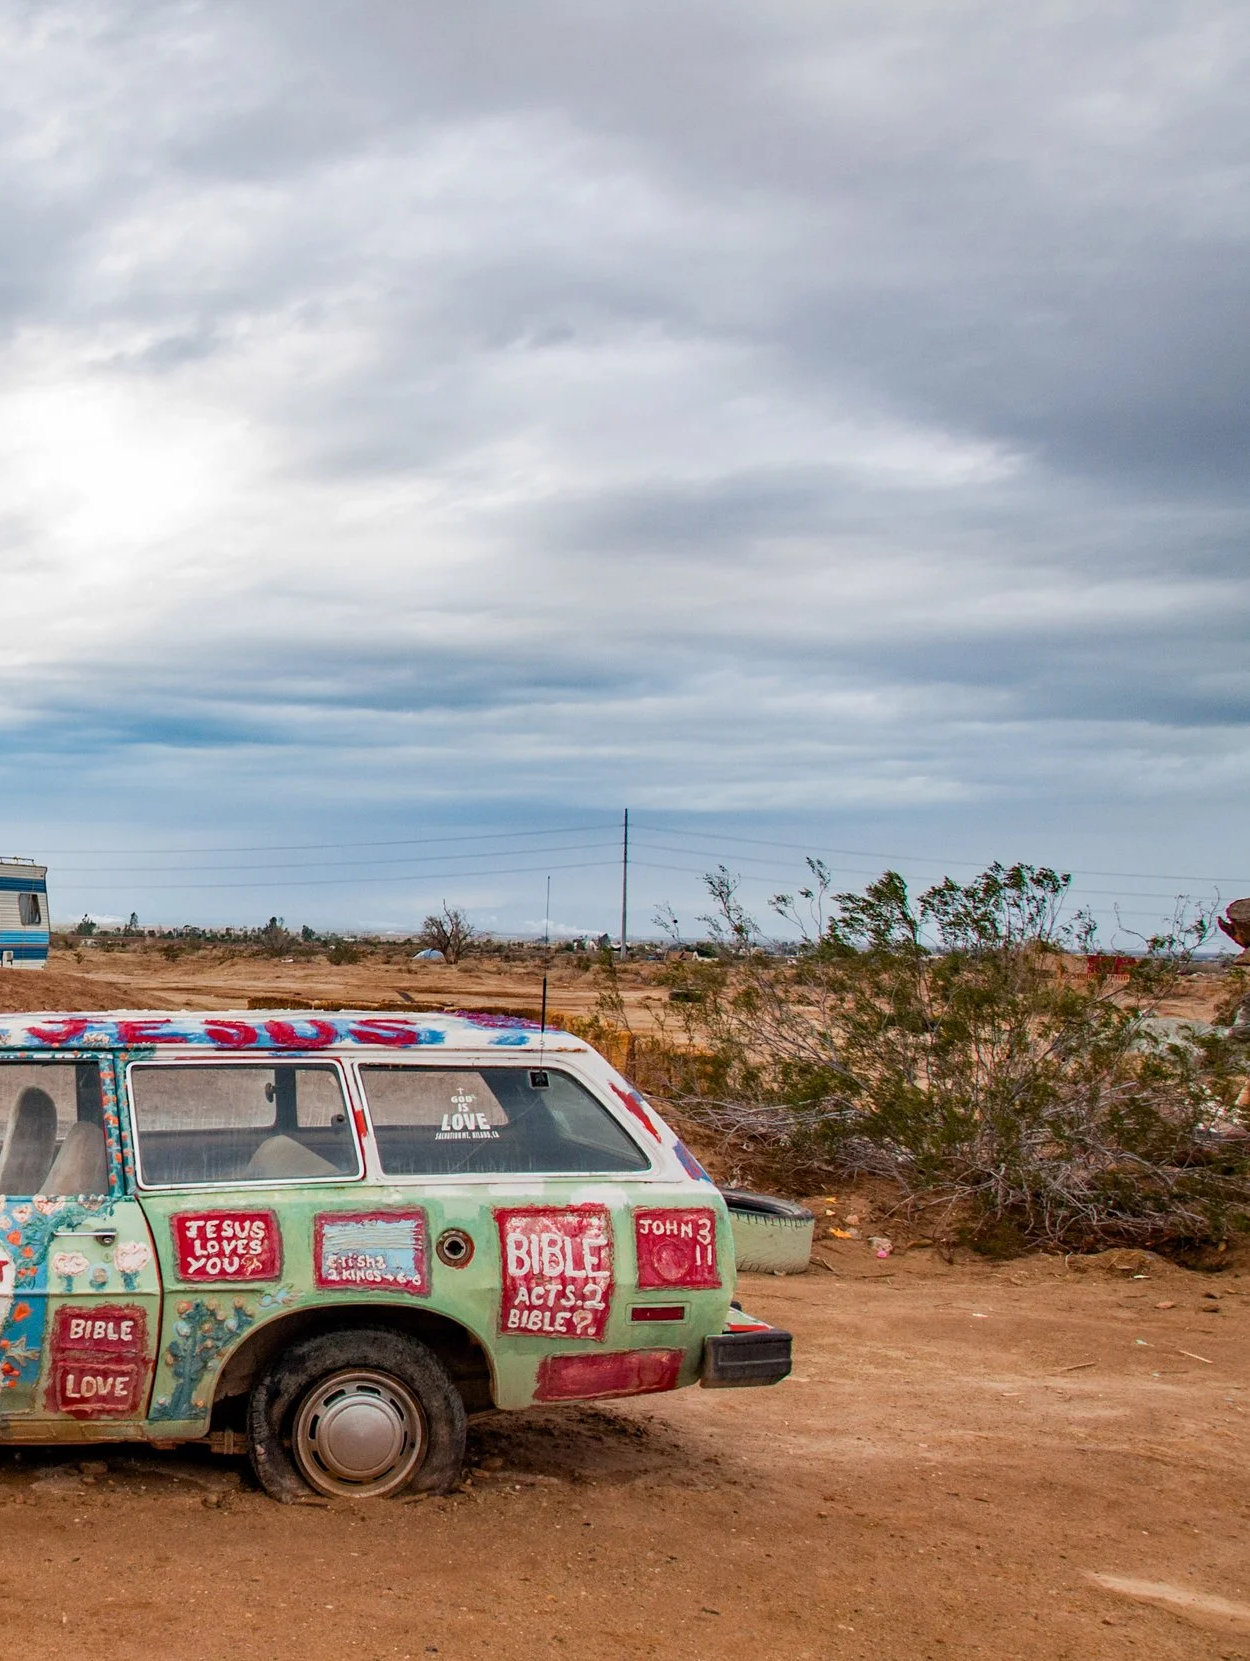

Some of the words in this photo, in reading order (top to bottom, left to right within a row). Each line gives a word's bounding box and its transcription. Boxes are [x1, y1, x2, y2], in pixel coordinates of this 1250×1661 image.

[23, 1018, 415, 1048] JESUS
[451, 1095, 473, 1104] GOD
[458, 1103, 469, 1112] IS
[441, 1112, 491, 1131] LOVE
[185, 1220, 266, 1239] JESUS
[639, 1219, 693, 1238] JOHN
[697, 1218, 712, 1245] 3
[194, 1239, 263, 1257] LOVES
[506, 1231, 611, 1279] BIBLE
[695, 1244, 713, 1266] 11
[327, 1268, 340, 1281] 2
[341, 1269, 382, 1283] KINGS
[70, 1319, 134, 1341] BIBLE
[66, 1374, 130, 1398] LOVE
